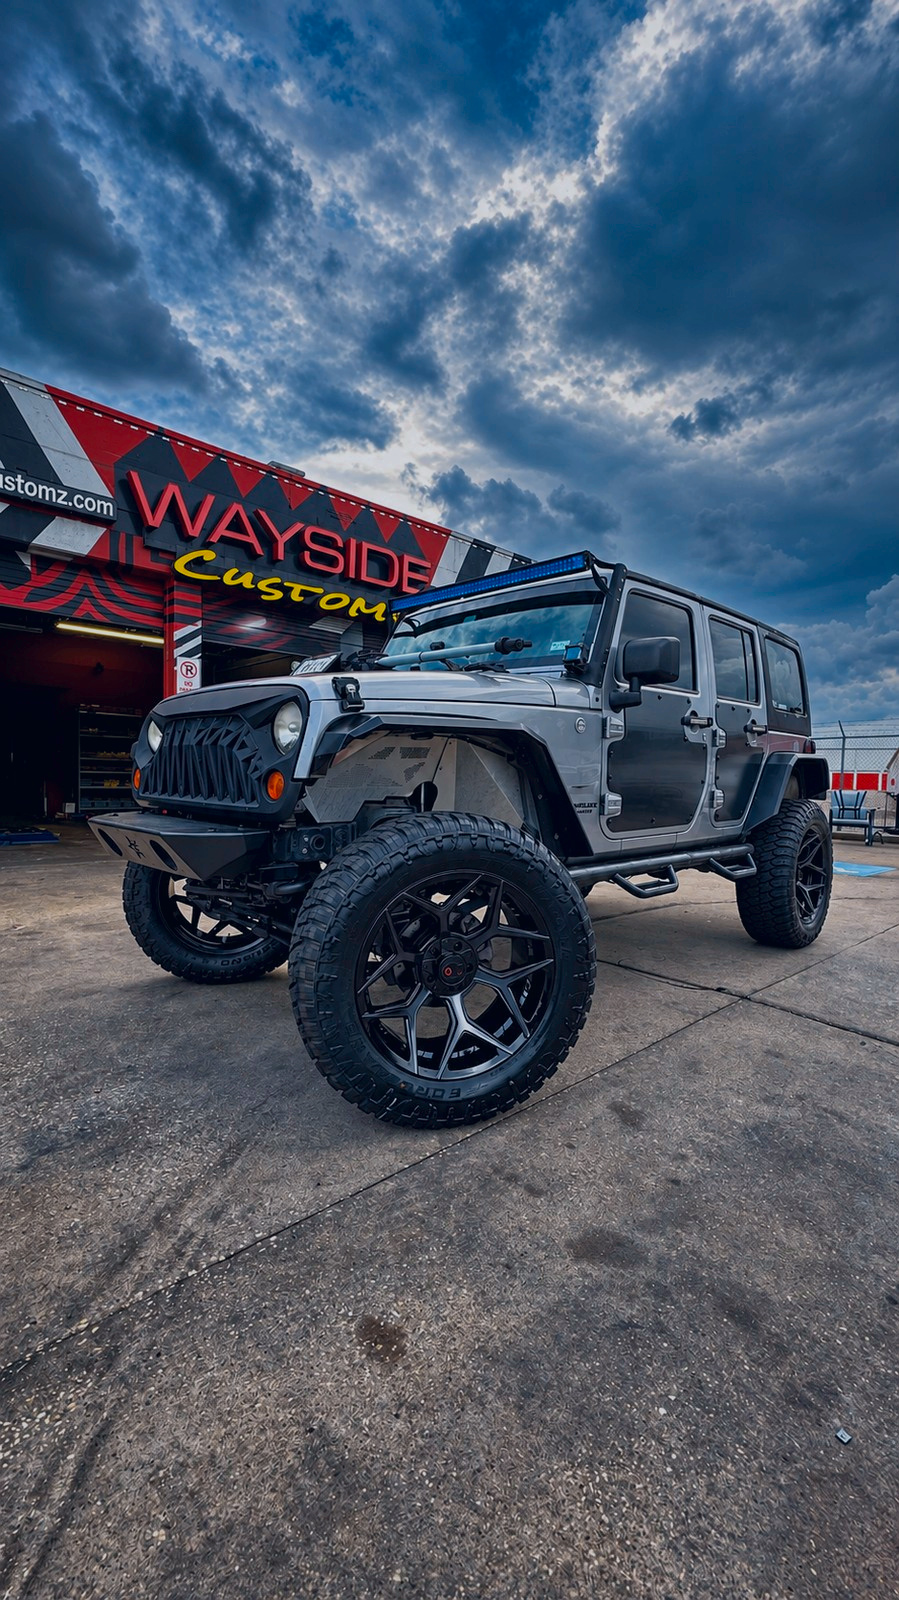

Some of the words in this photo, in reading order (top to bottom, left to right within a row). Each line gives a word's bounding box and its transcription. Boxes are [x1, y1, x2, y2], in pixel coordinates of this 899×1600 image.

[0, 474, 114, 517] stomz.com
[126, 470, 432, 594] WAYSIDE
[173, 549, 400, 622] Custom
